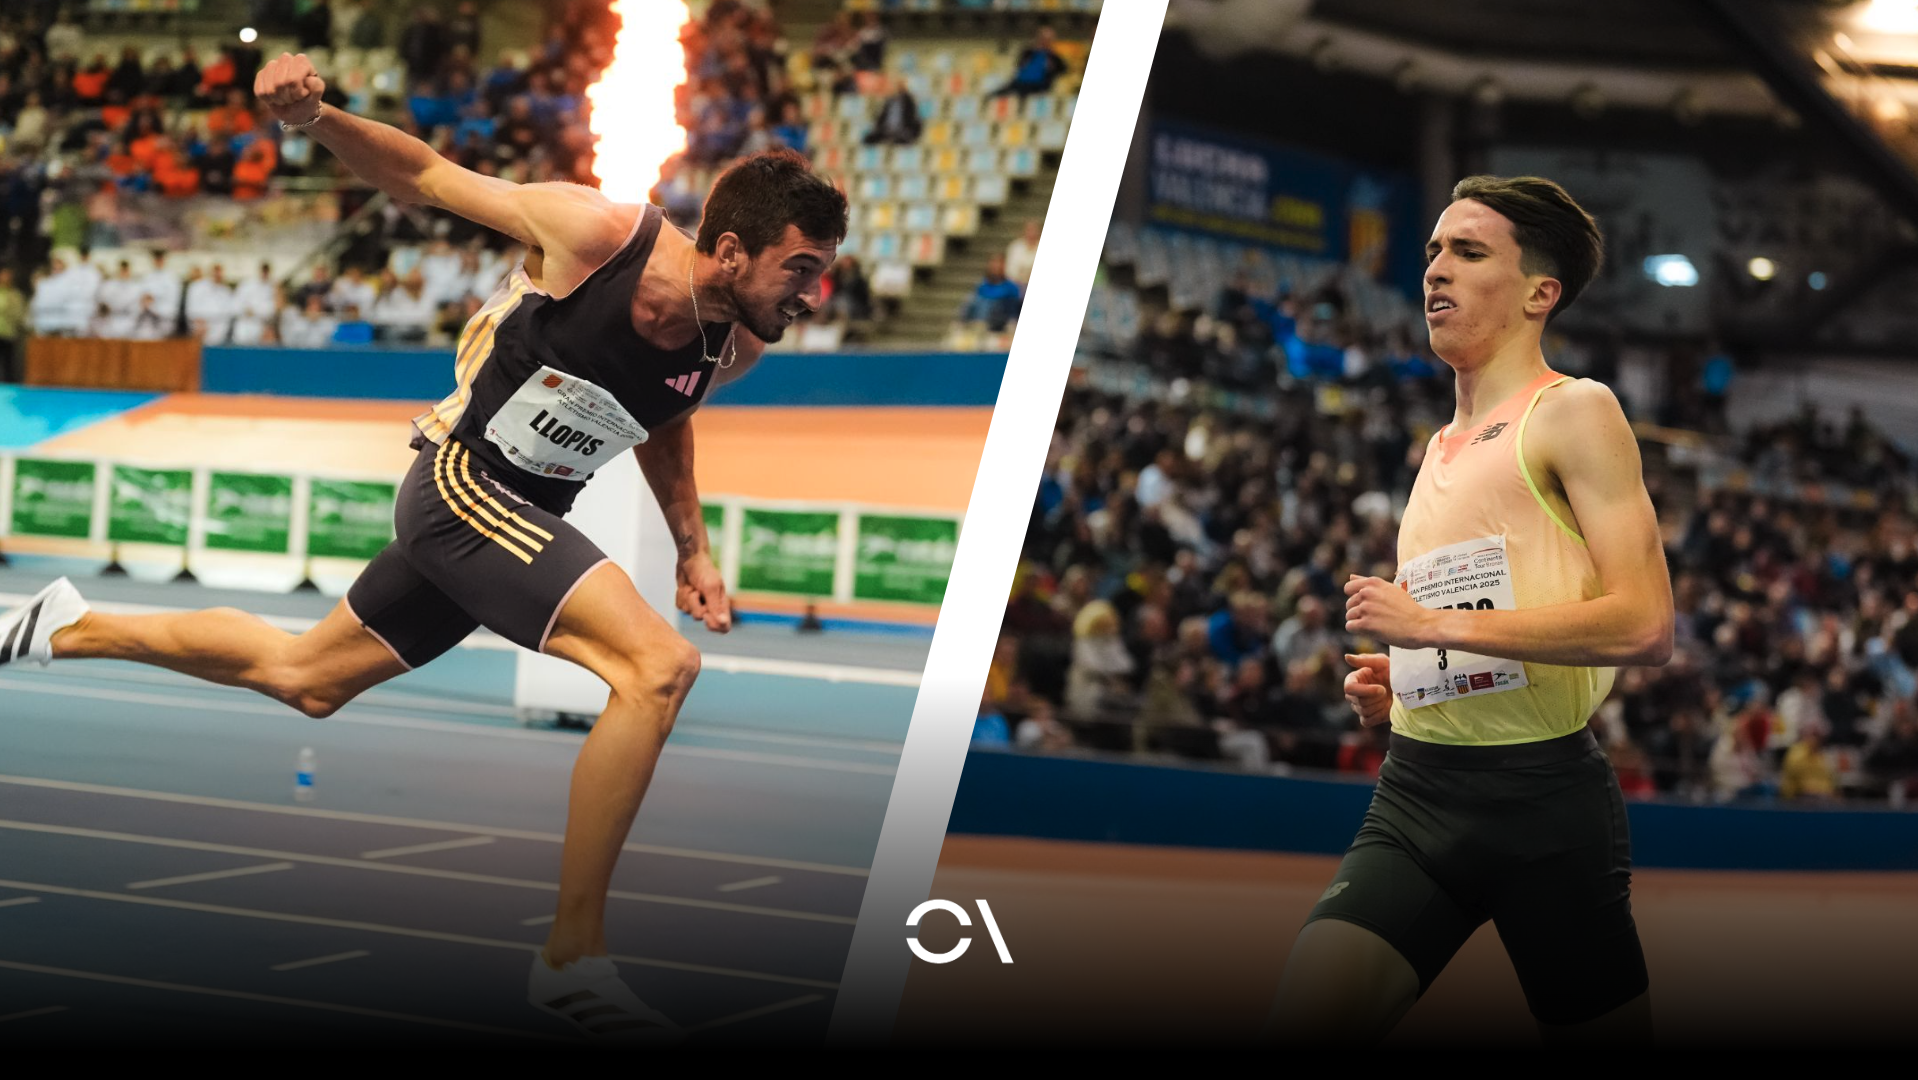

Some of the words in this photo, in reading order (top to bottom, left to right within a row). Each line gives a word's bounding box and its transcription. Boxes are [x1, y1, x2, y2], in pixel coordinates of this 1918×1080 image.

[557, 389, 575, 405] GRAN
[574, 403, 598, 418] PREMIO
[557, 399, 591, 421] ATLETISMO
[590, 418, 620, 436] VALENCIA
[529, 409, 604, 456] LLOPIS
[1413, 591, 1441, 602] TLETISMO
[1441, 583, 1478, 596] VALENCIA
[1480, 579, 1500, 589] 2025
[1421, 581, 1443, 593] PREMIO
[1444, 570, 1506, 586] INTERNACIONAL
[1437, 649, 1447, 670] 3
